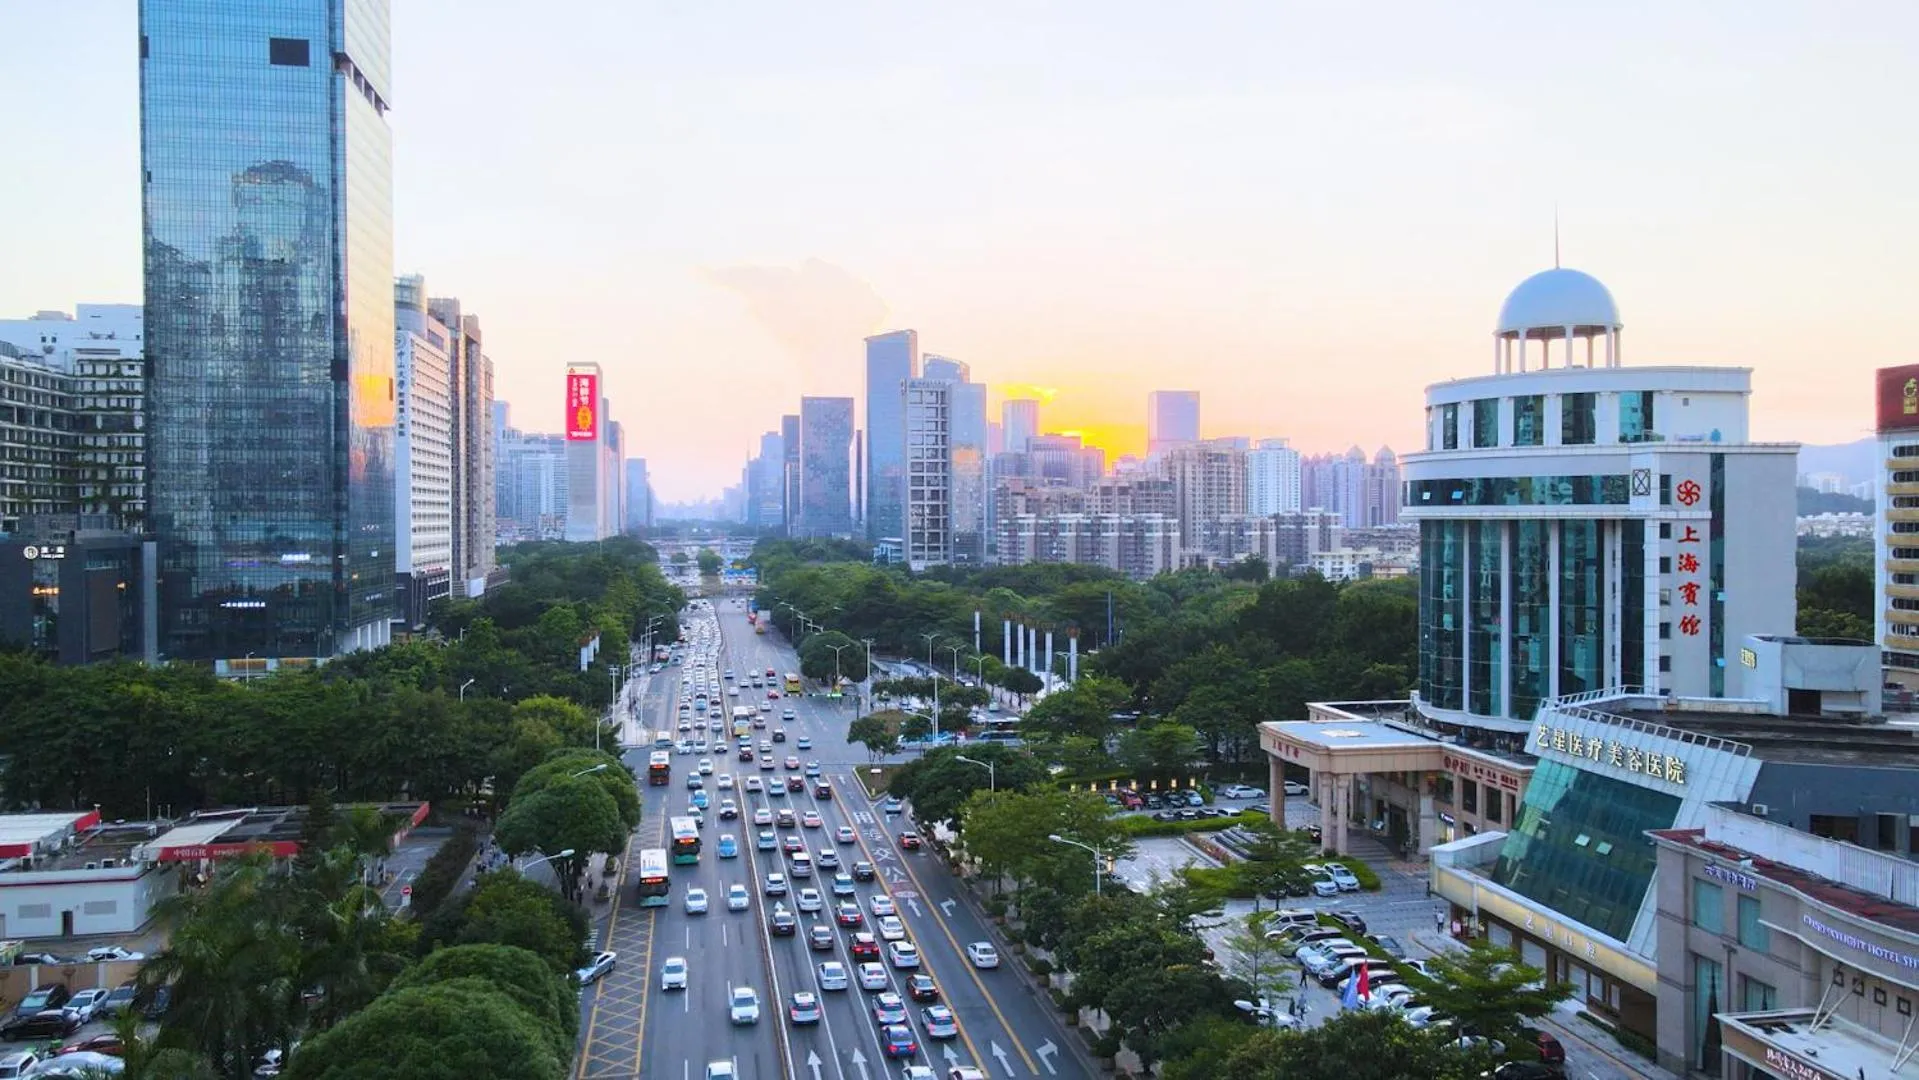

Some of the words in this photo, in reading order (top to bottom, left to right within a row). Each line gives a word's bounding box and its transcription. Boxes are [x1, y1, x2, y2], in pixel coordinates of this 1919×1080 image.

[1536, 724, 1686, 784] 艺星医疗美容医院
[1867, 943, 1899, 963] HOTEL
[1903, 955, 1919, 969] SH
